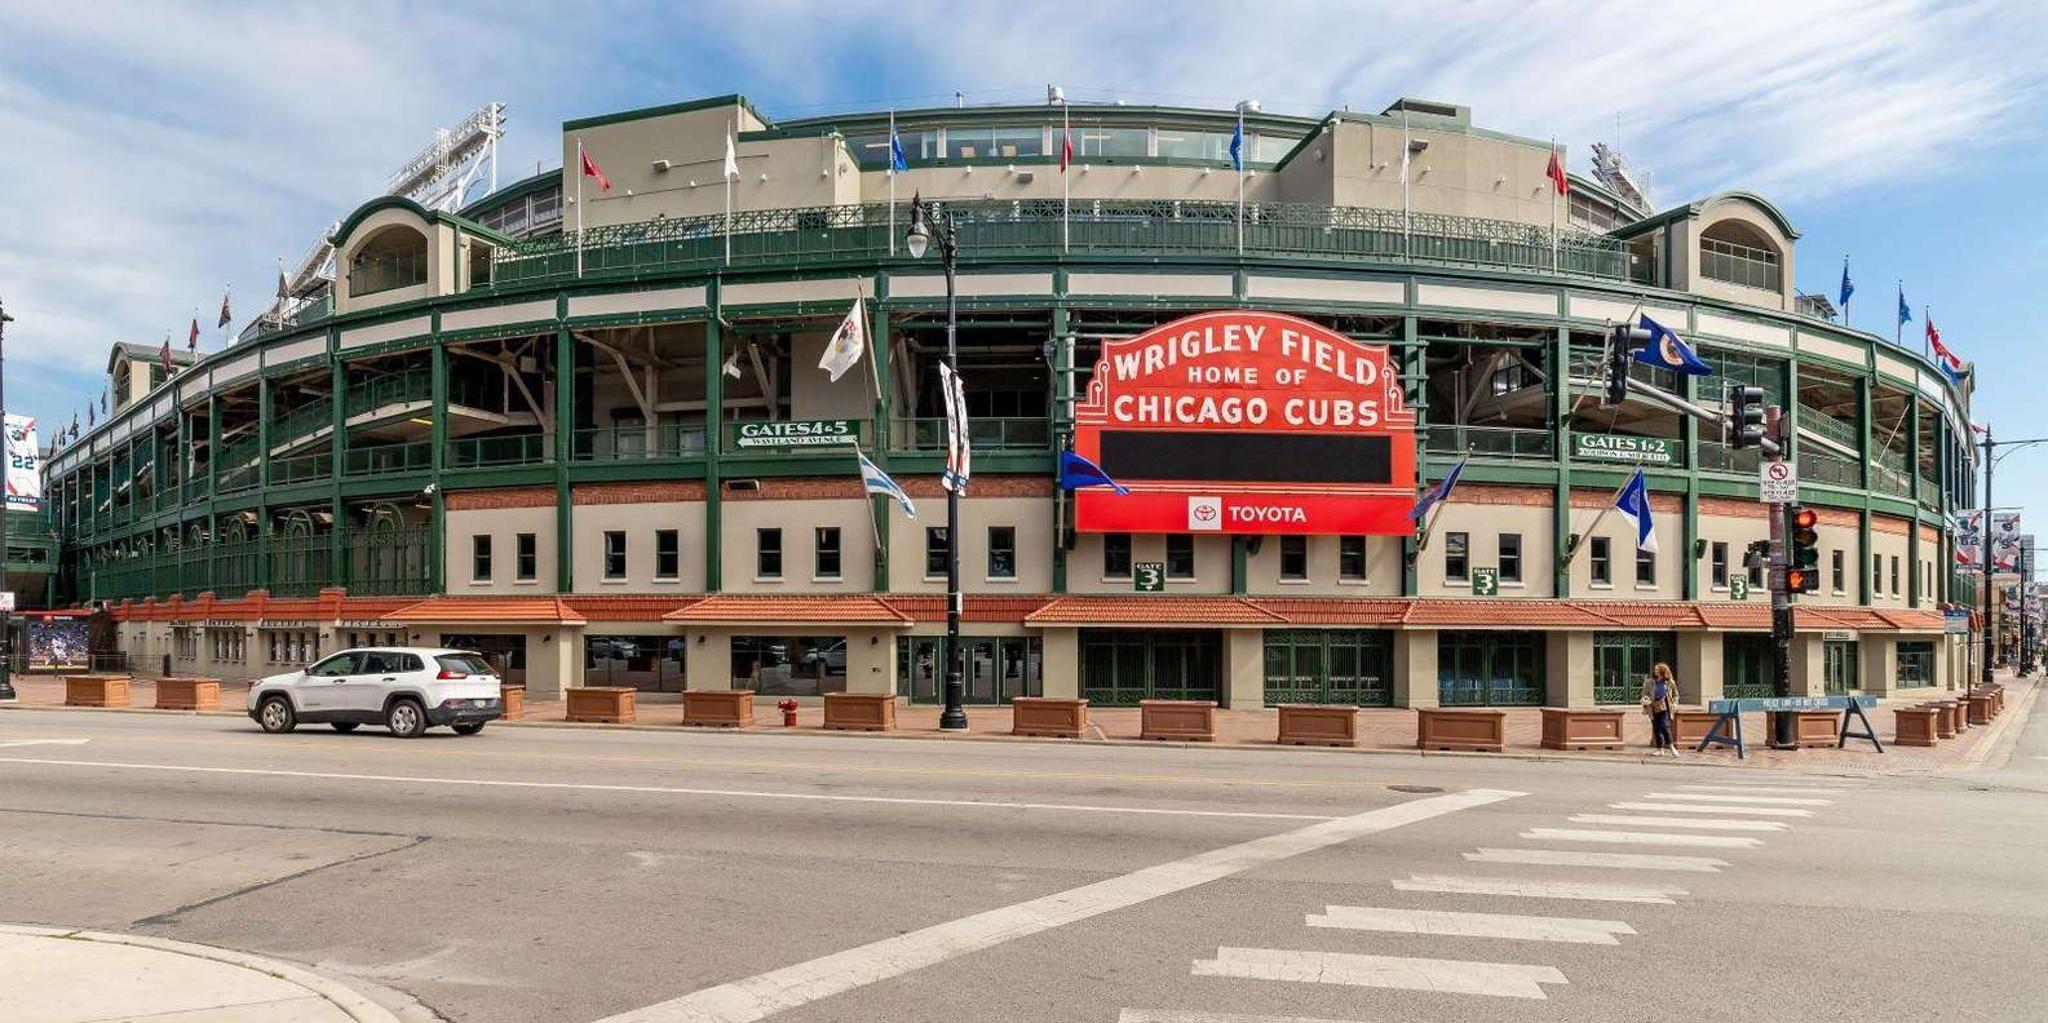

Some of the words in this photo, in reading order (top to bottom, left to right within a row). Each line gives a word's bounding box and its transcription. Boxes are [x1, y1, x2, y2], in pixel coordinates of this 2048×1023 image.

[1114, 324, 1266, 381] WRIGLEY
[1282, 329, 1377, 385] FIELD
[1187, 366, 1259, 385] HOME
[1275, 368, 1307, 385] OF
[1114, 394, 1268, 424] CHICAGO
[1284, 398, 1378, 426] CUBS
[741, 422, 810, 437] GATES
[1581, 434, 1637, 450] GATES
[12, 455, 35, 470] 22
[1229, 506, 1307, 523] TOYOTA
[1139, 569, 1159, 586] 3
[1477, 574, 1493, 590] 3
[1733, 580, 1744, 595] 3
